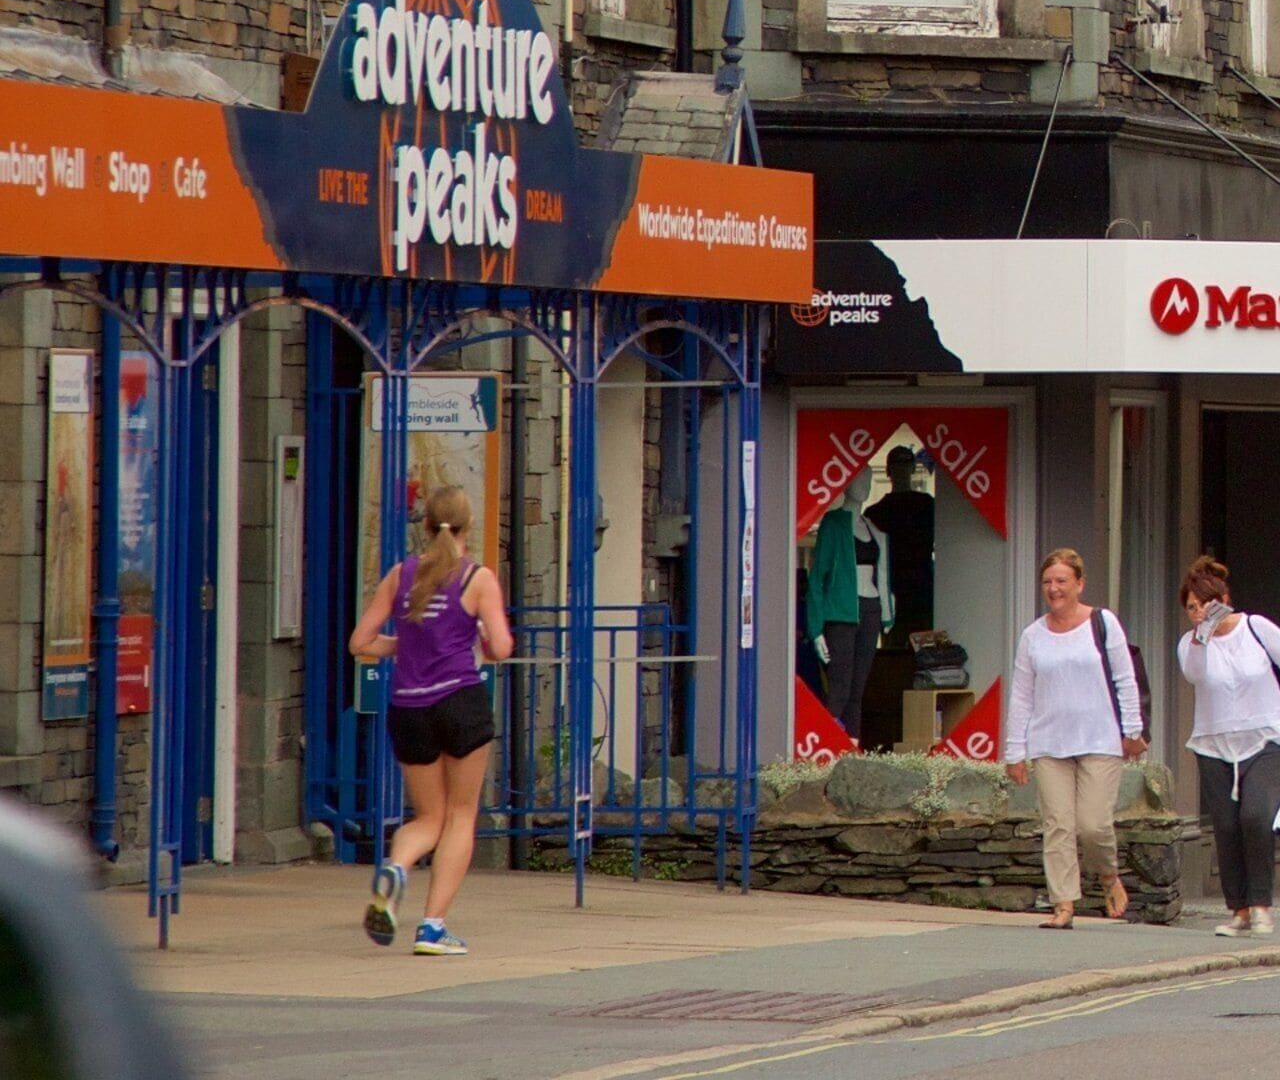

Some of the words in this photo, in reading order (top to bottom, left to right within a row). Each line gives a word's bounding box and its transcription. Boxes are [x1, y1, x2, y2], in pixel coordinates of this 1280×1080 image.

[51, 146, 86, 190] Wall
[108, 151, 150, 204] Shop
[173, 156, 207, 200] Cafe
[319, 169, 344, 203] LIVE
[346, 170, 369, 206] THE
[395, 122, 518, 272] peaks
[525, 189, 564, 224] DREAM
[638, 203, 695, 242] Worldwide
[696, 209, 757, 251] Expeditions
[758, 214, 768, 248] &
[769, 215, 808, 252] Courses
[811, 290, 893, 307] adventure
[829, 307, 880, 327] peaks
[408, 398, 459, 410] mbleside
[434, 413, 459, 424] wall
[808, 428, 875, 506] sale
[926, 423, 992, 500] sale
